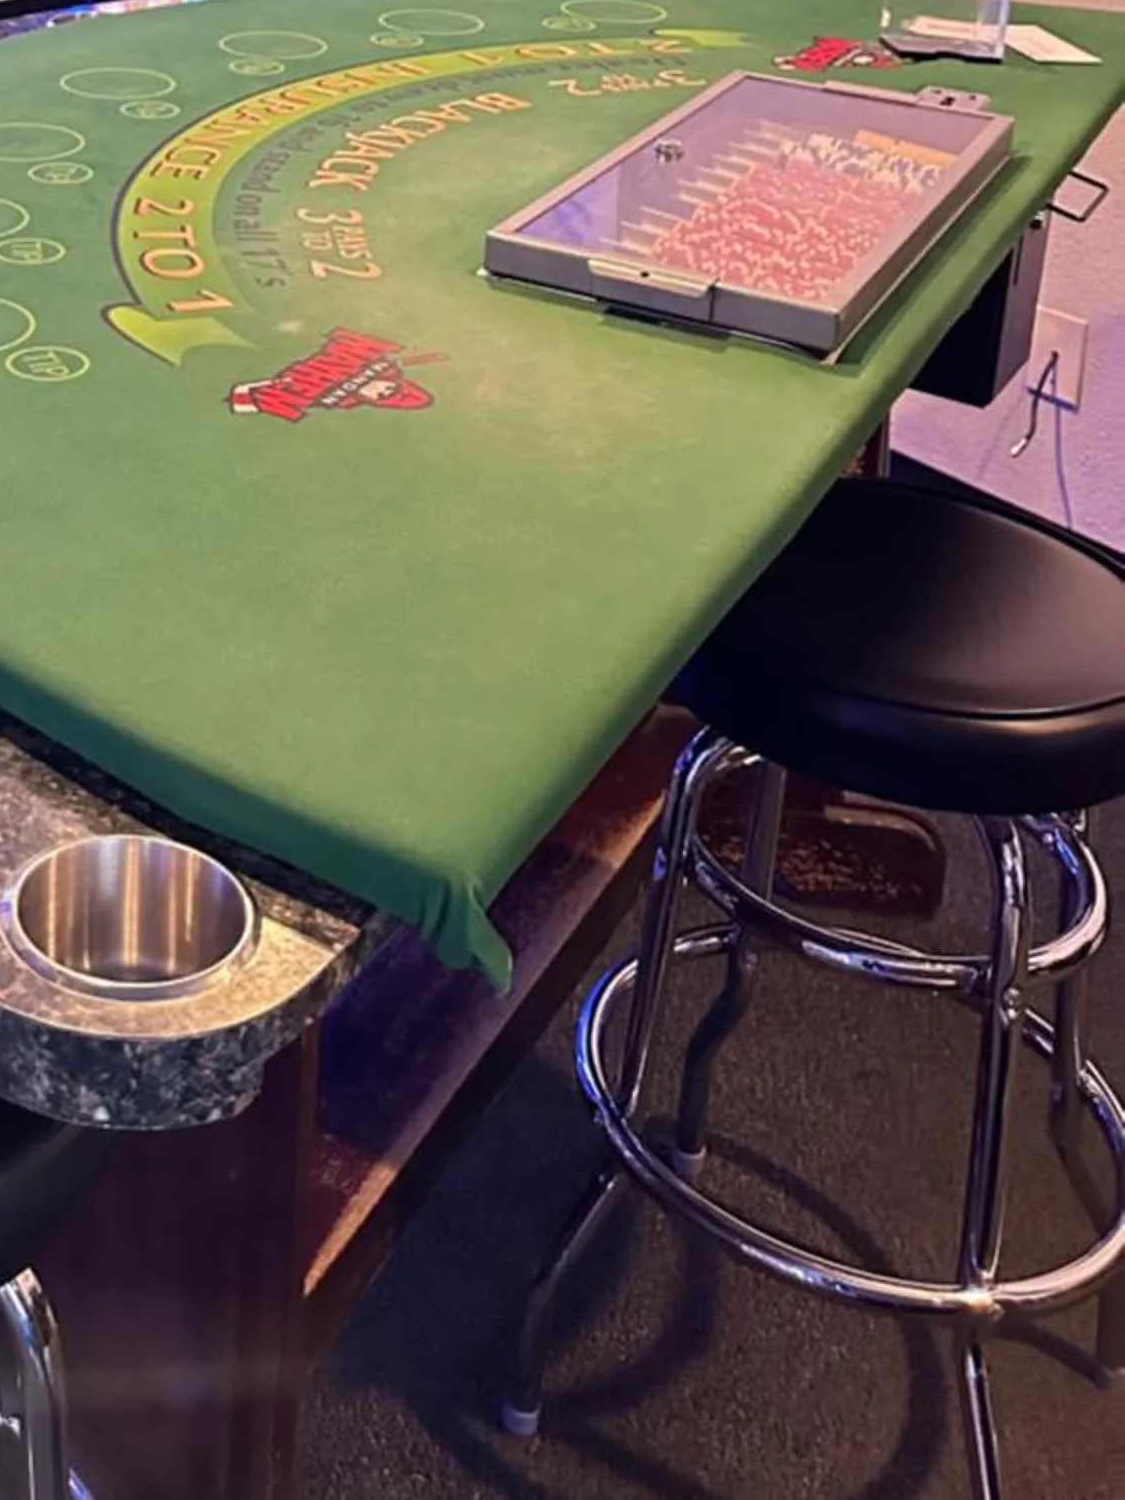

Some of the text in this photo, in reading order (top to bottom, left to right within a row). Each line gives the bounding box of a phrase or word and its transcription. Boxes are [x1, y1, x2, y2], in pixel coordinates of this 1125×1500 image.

[150, 61, 431, 180] INSURANCE
[307, 92, 532, 191] BLACKJACK
[134, 196, 194, 217] 2
[296, 208, 363, 224] 3
[132, 224, 205, 279] TO
[309, 259, 383, 278] 2
[166, 289, 233, 312] 1
